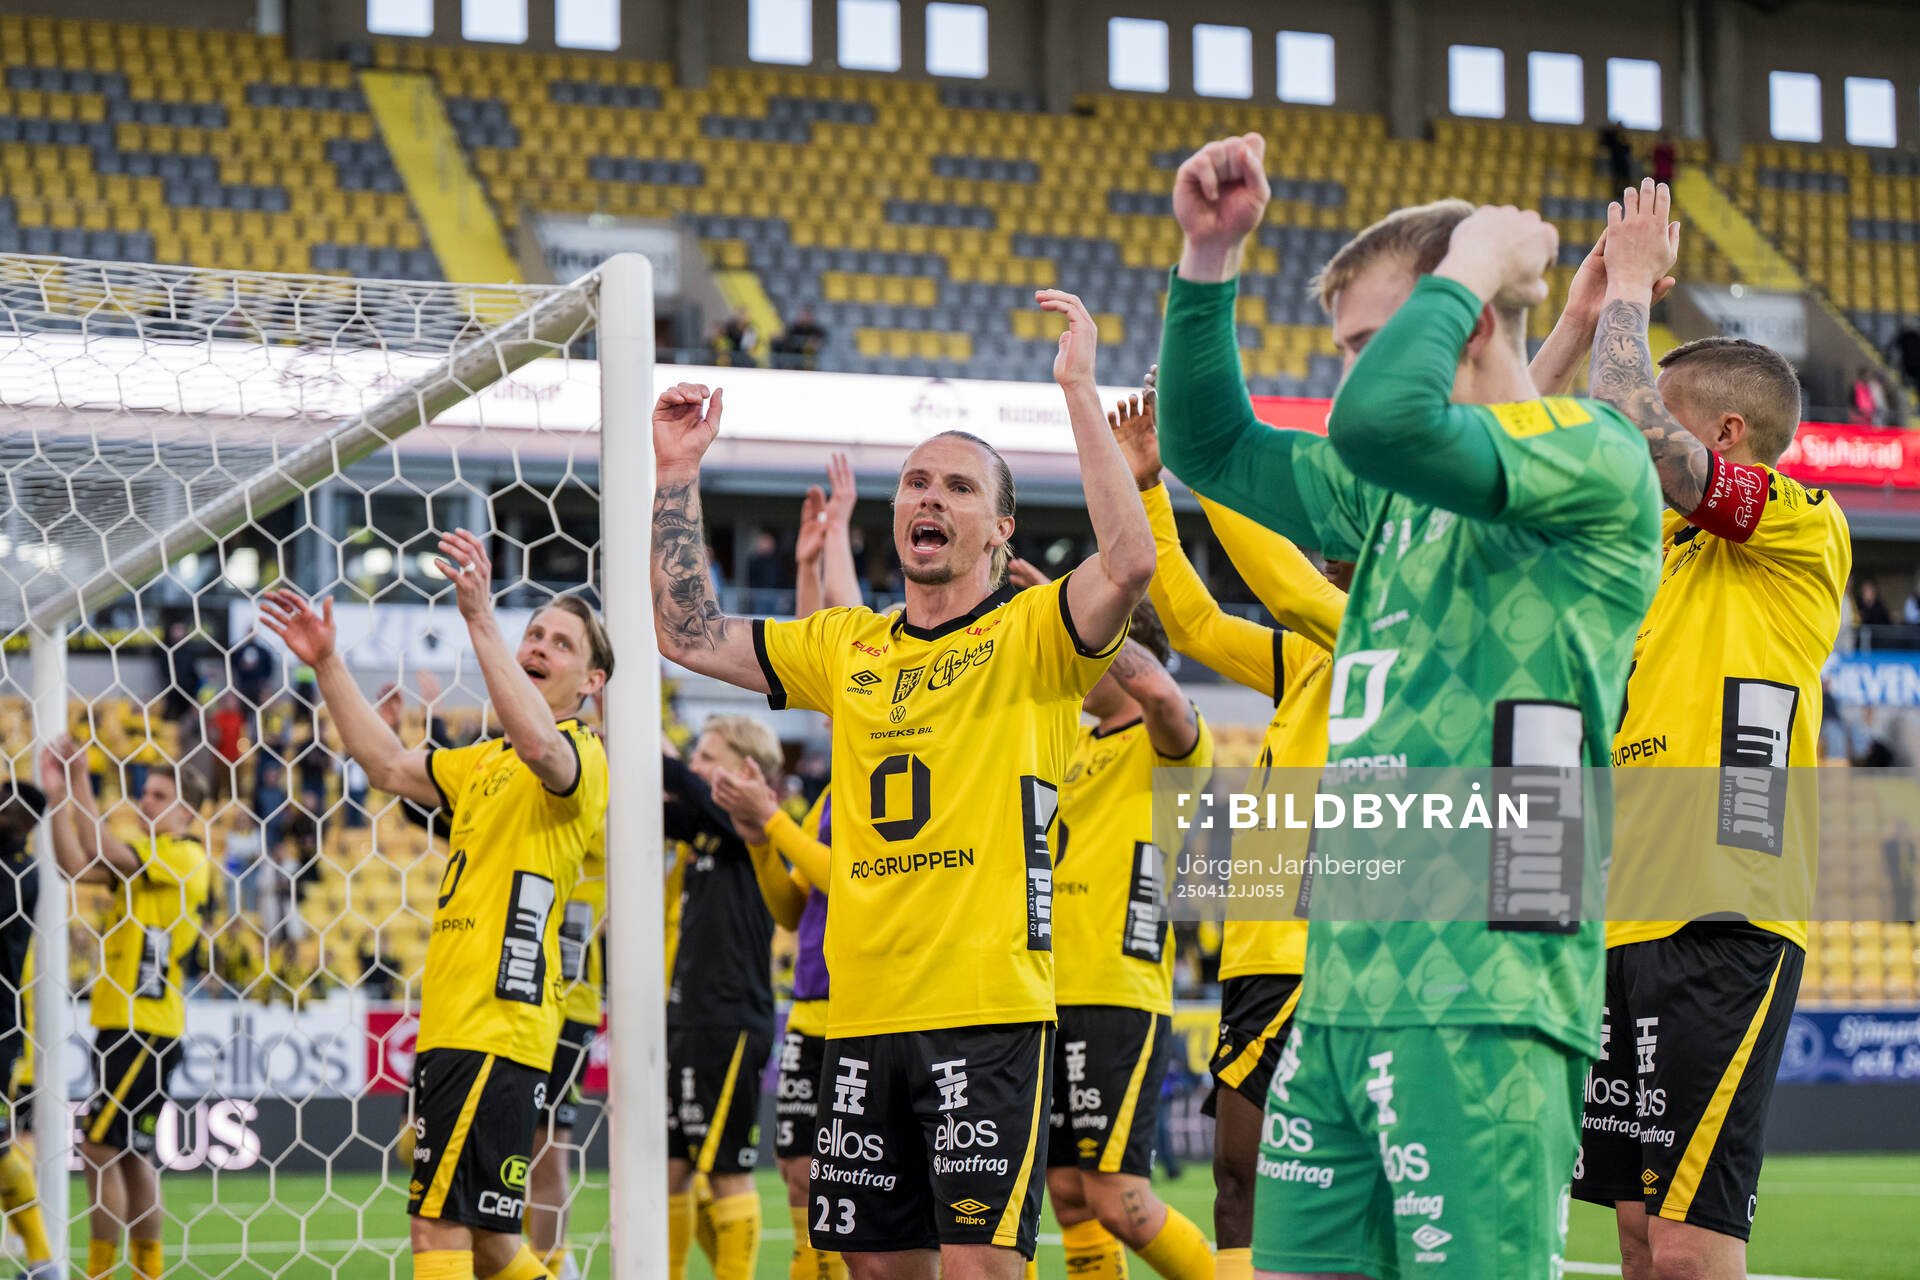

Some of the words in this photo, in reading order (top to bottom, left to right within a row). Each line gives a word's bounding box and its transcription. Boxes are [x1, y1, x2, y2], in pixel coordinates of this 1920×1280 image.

[927, 639, 994, 691] Elfsborg
[846, 686, 873, 696] umbro
[870, 728, 915, 740] TOVEKS
[917, 726, 933, 735] BIL
[851, 848, 974, 879] RO-GRUPPEN
[817, 1118, 884, 1162] ellos
[934, 1113, 999, 1151] ellos
[821, 1163, 897, 1192] Skrotfrag
[813, 1196, 857, 1235] 23
[955, 1215, 986, 1225] umbro
